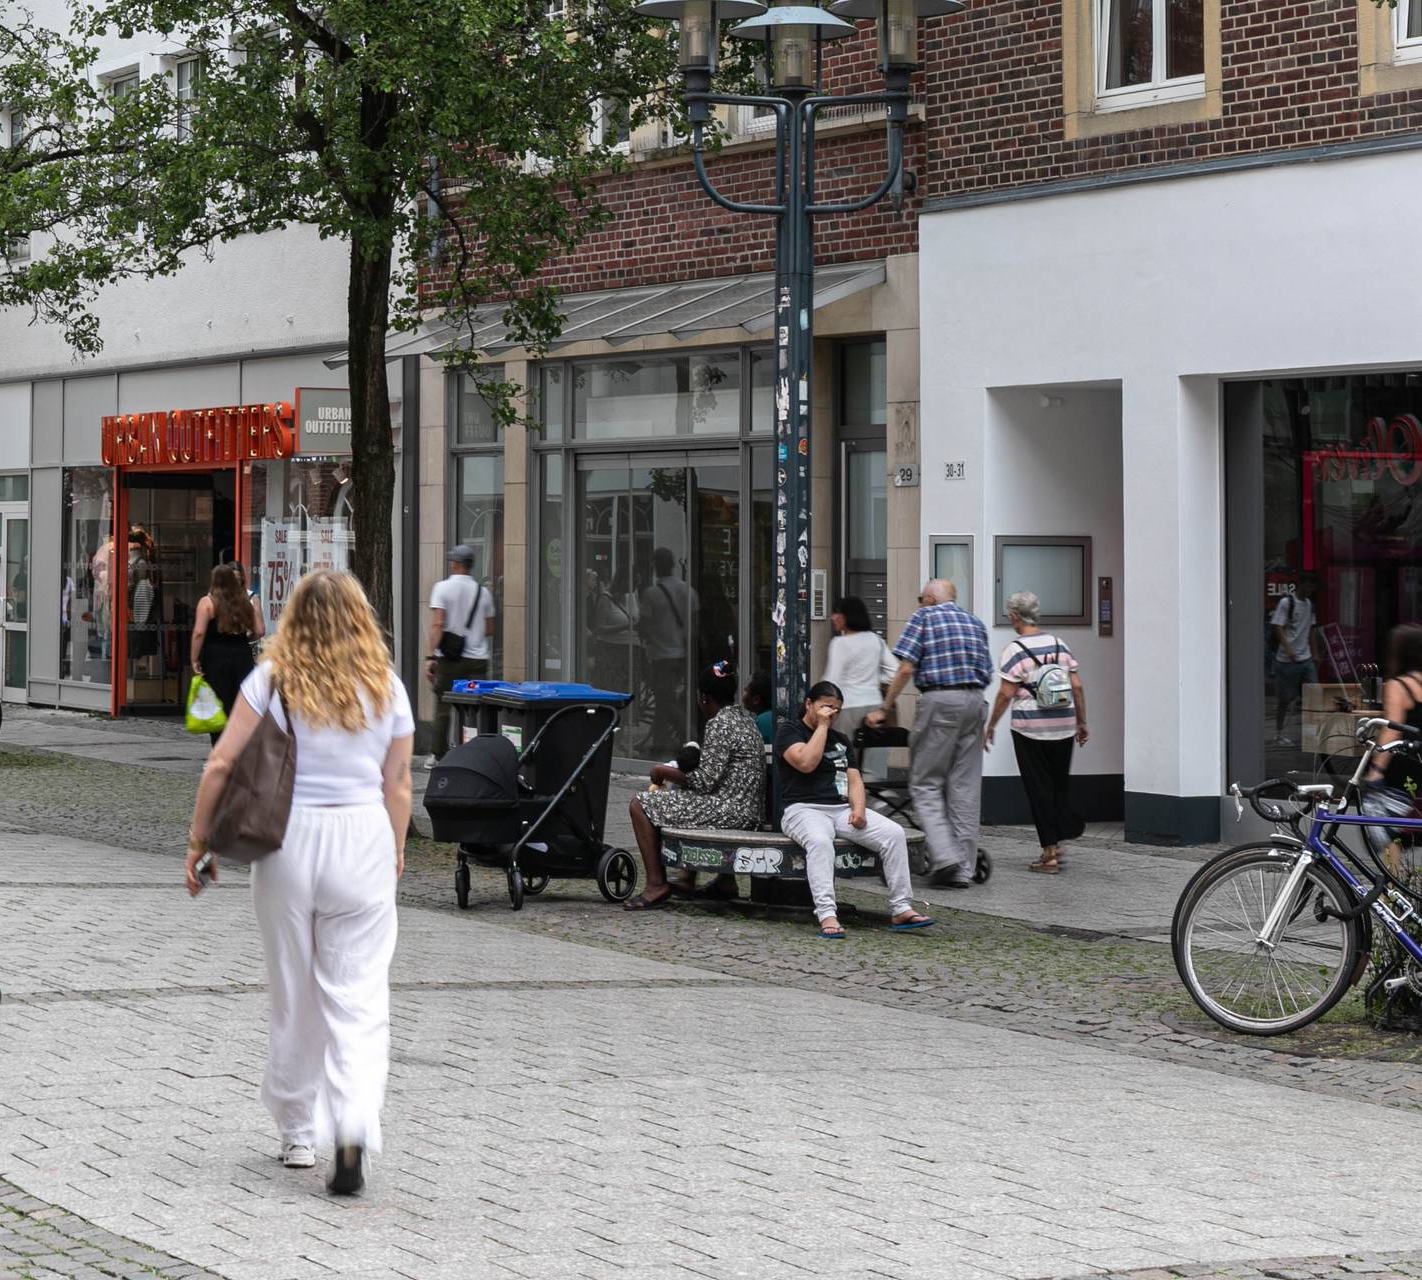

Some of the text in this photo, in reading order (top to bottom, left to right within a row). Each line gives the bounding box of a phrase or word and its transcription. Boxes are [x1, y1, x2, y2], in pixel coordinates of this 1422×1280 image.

[318, 407, 351, 421] URBAN
[306, 420, 351, 434] OUTFITTE
[899, 468, 913, 481] 29
[946, 464, 964, 477] 30-31
[275, 530, 287, 543] SALE
[267, 561, 294, 600] 75%
